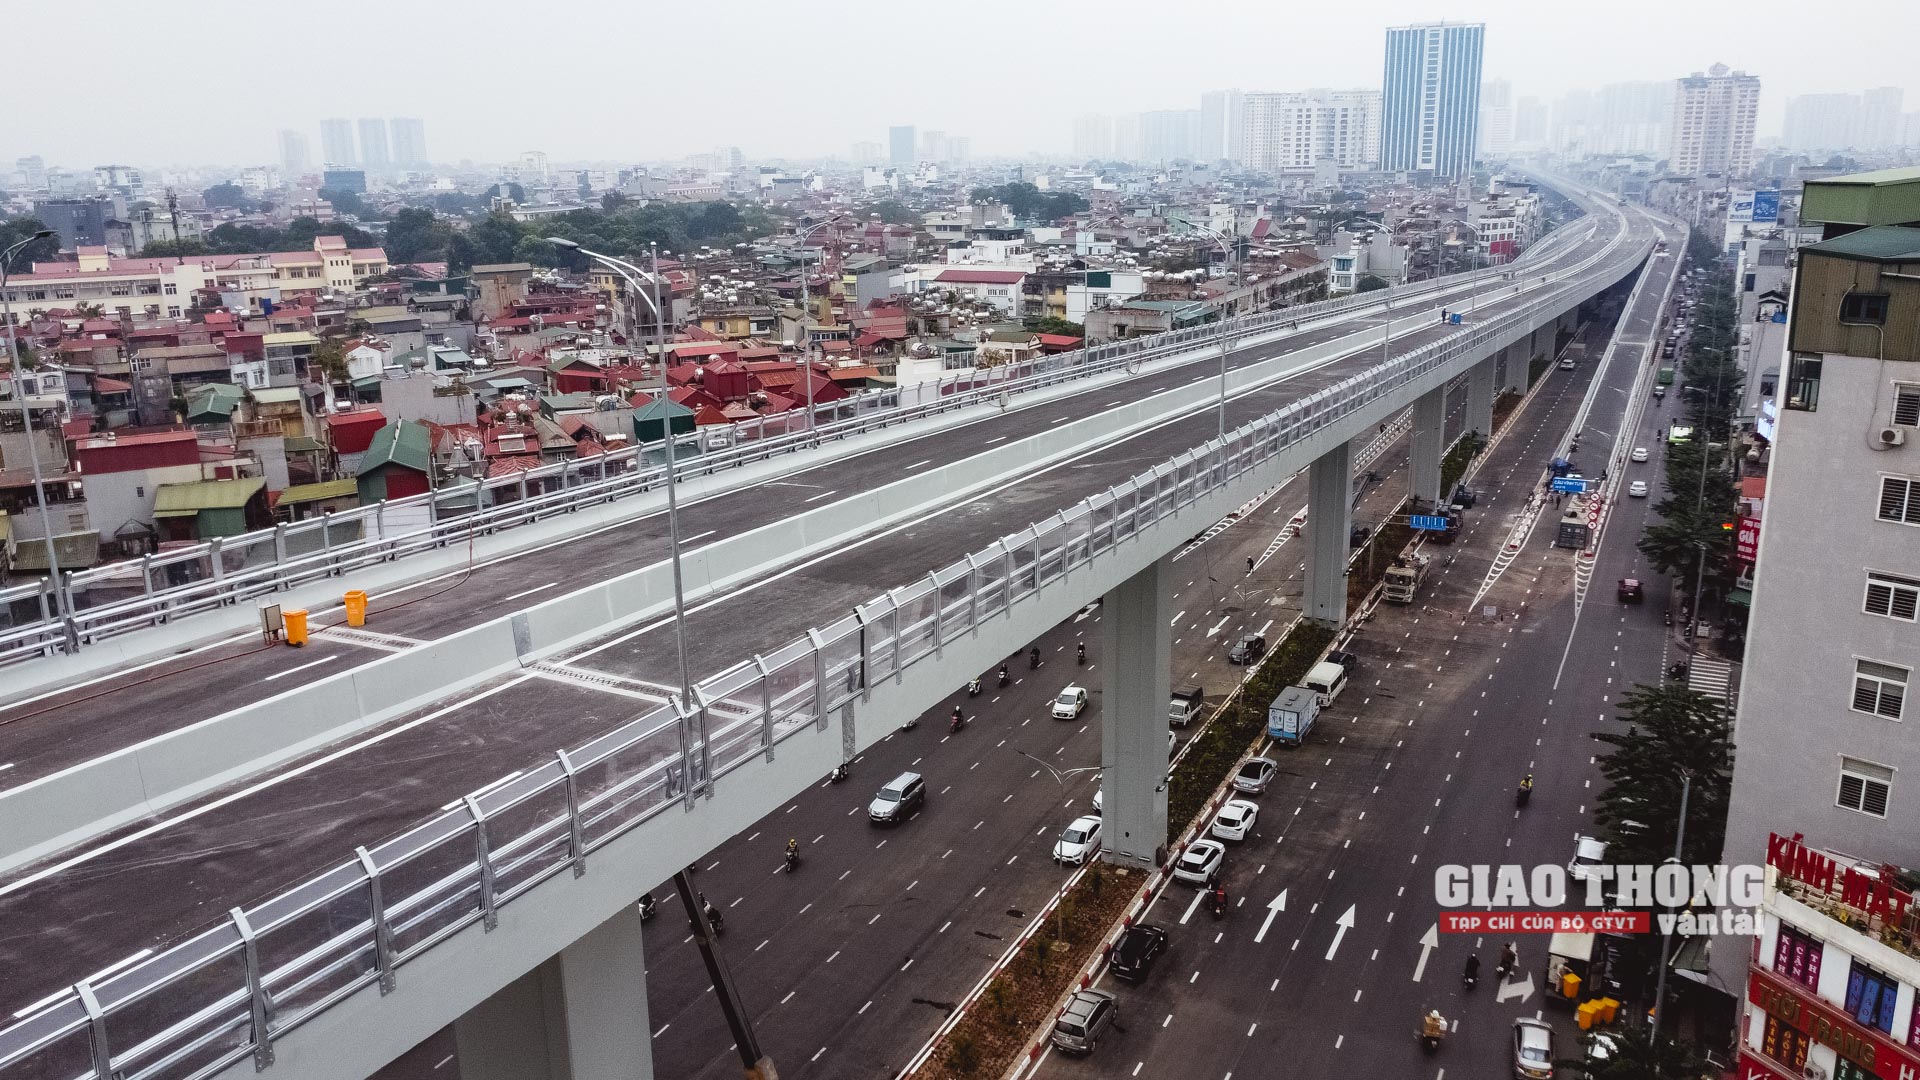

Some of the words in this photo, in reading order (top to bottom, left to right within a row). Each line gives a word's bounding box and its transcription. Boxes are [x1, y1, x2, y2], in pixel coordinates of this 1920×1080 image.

[1739, 529, 1755, 545] GIÁ
[1766, 832, 1836, 894] KÍNH
[1777, 934, 1790, 973] KÍNH
[1766, 1017, 1779, 1056] KÍNH
[1807, 1009, 1876, 1068] TRANG
